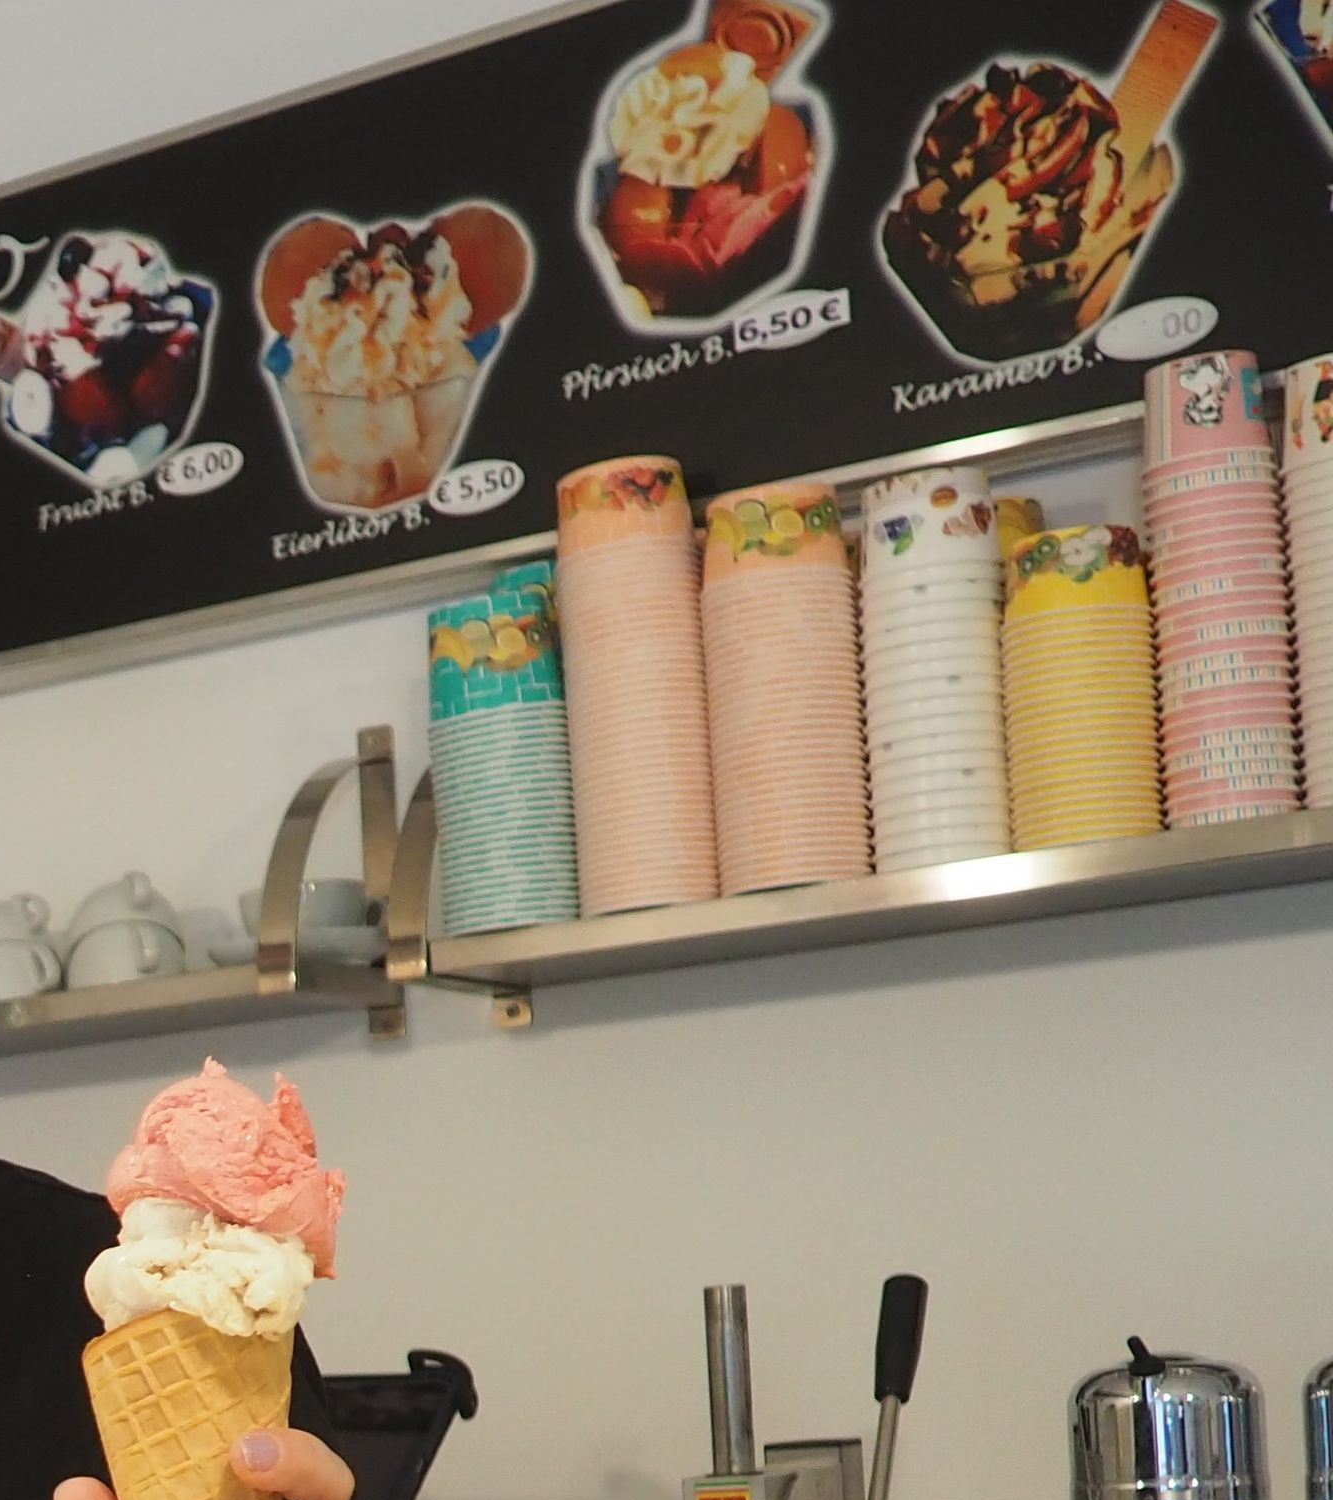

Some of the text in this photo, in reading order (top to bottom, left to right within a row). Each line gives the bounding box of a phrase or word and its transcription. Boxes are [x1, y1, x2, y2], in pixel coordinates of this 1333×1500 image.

[738, 297, 843, 343] 6,50 €
[700, 334, 733, 366] B.
[183, 448, 234, 482] 6,00
[436, 464, 517, 505] € 5,50
[37, 480, 155, 534] Frucht B.
[269, 502, 432, 561] Eierlikör B.
